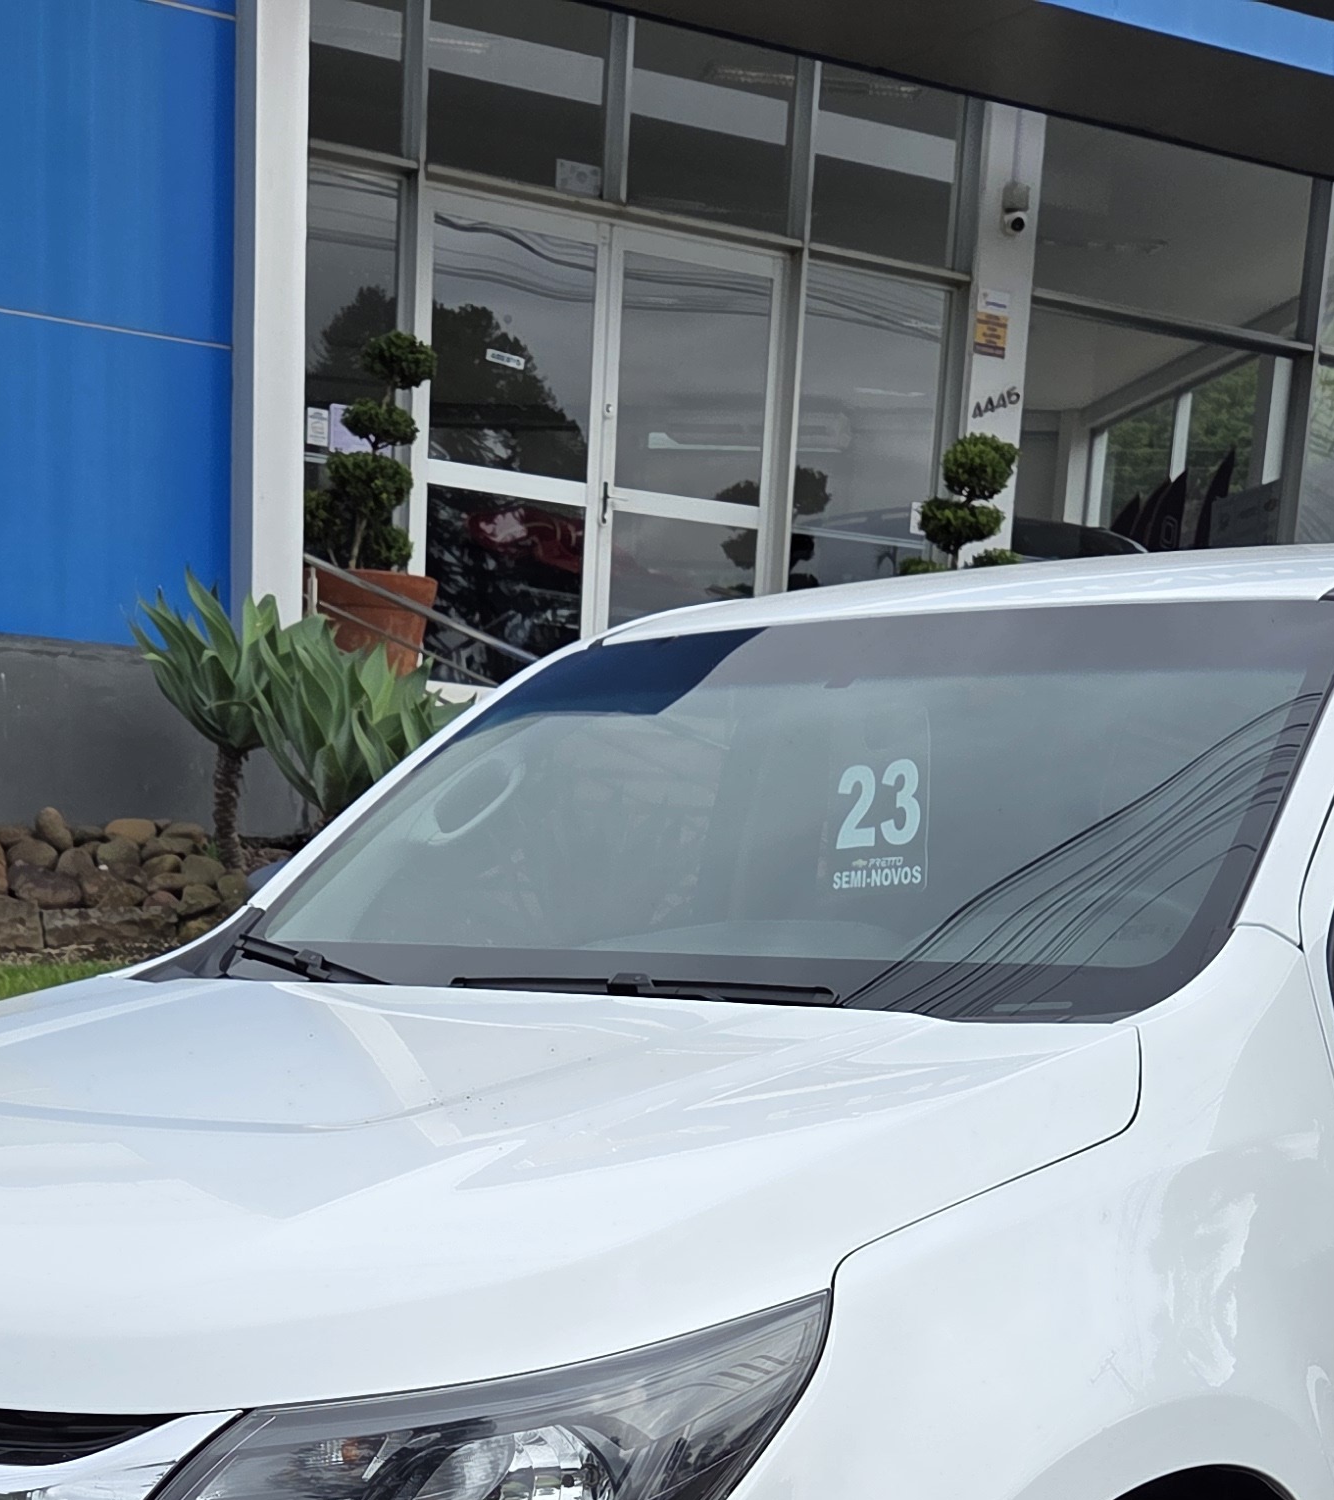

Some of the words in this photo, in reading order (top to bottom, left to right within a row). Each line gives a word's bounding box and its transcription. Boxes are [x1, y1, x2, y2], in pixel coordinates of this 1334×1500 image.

[835, 758, 921, 849] 23
[868, 856, 904, 868] PRETTO
[833, 865, 922, 890] SEMI-NOVOS
